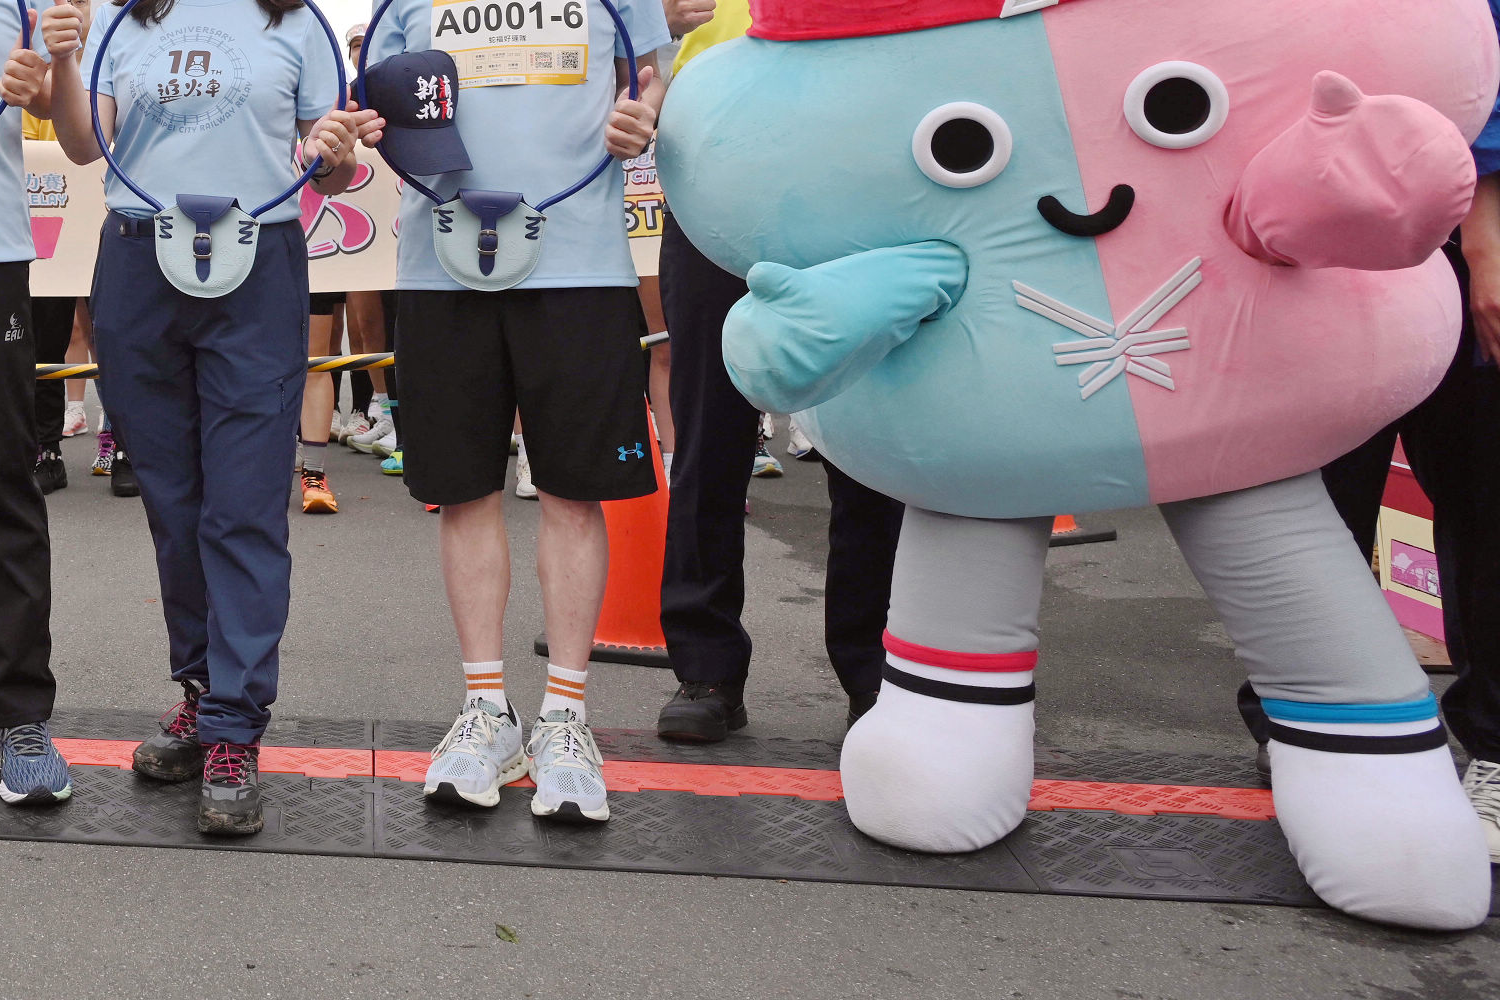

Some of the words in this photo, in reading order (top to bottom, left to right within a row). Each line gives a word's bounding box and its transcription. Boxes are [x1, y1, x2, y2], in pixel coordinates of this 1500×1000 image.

[435, 1, 584, 38] A0001-6
[160, 25, 236, 43] ANNIVERSARY
[168, 50, 212, 77] 10
[157, 78, 221, 104] 追火車
[134, 98, 151, 118] NEW
[151, 114, 176, 132] TAIPEI
[178, 125, 197, 134] CITY
[200, 106, 236, 133] RAILWAY
[235, 81, 253, 108] RELAY
